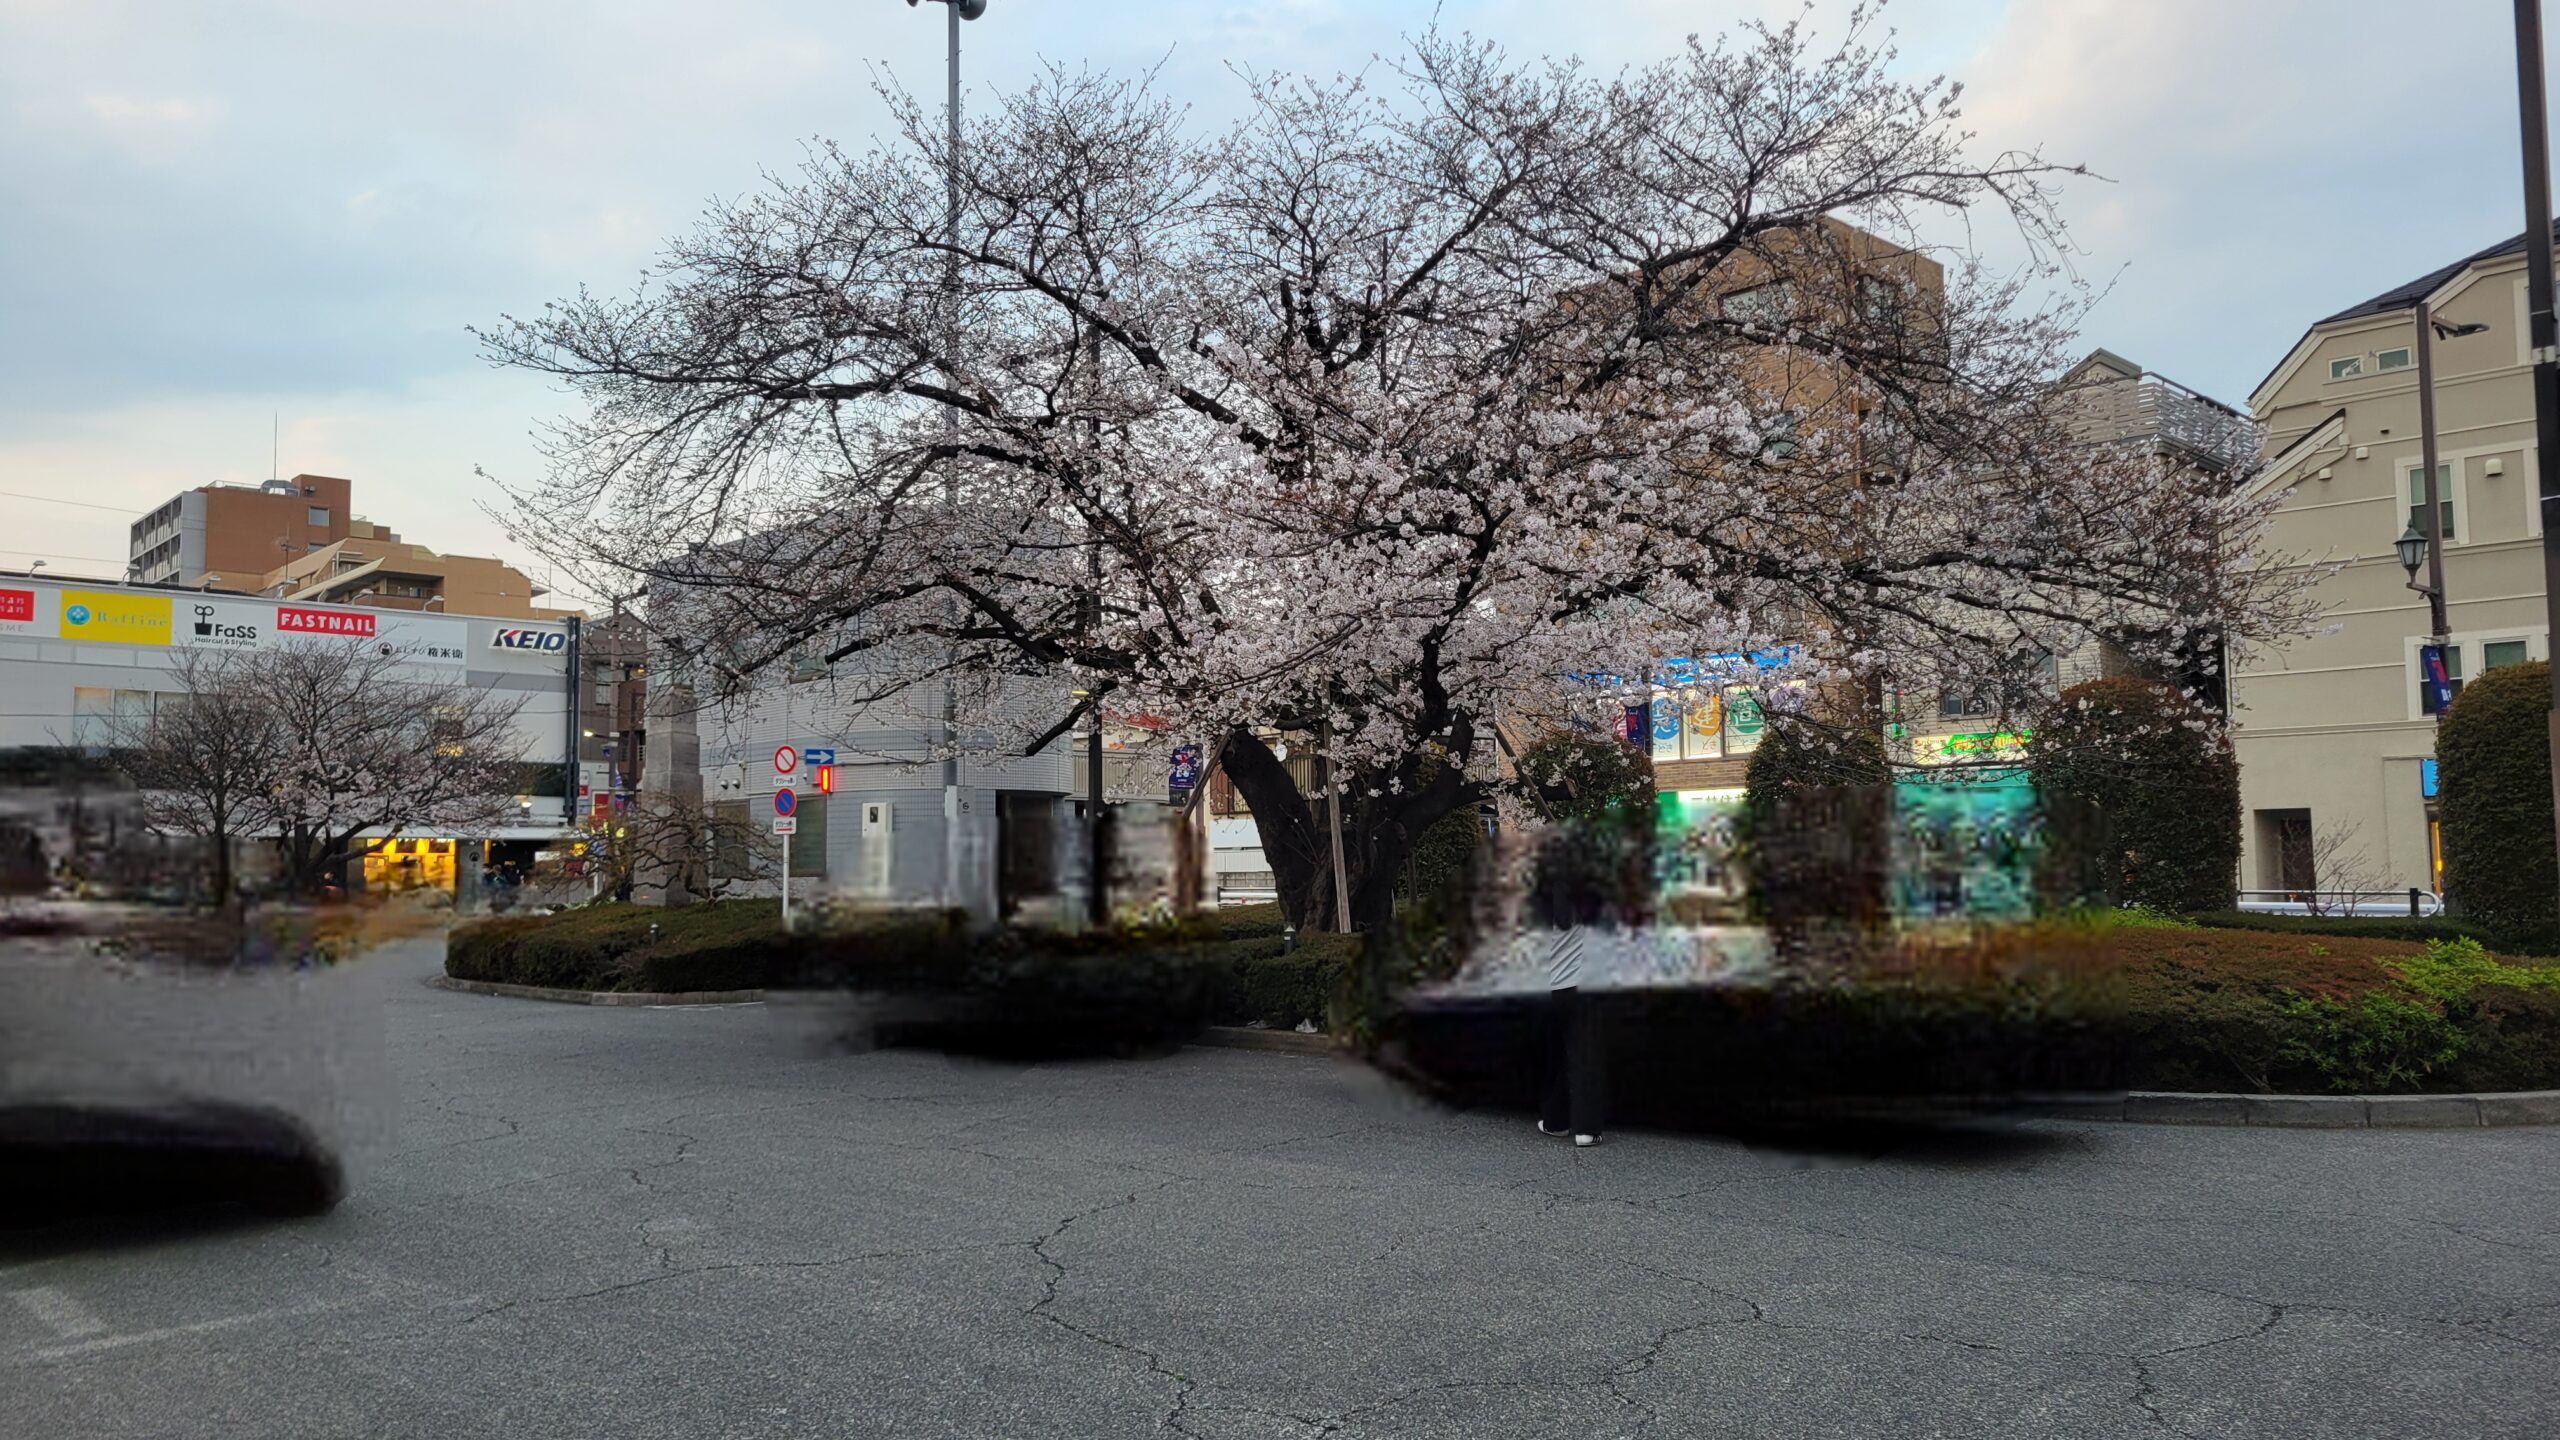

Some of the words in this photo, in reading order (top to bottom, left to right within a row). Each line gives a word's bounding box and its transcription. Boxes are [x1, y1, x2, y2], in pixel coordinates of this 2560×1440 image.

[281, 612, 374, 632] FASTNAIL
[215, 624, 257, 640] FaSS
[493, 628, 568, 650] KEIO
[194, 636, 224, 645] Haircut
[230, 639, 257, 648] Styling
